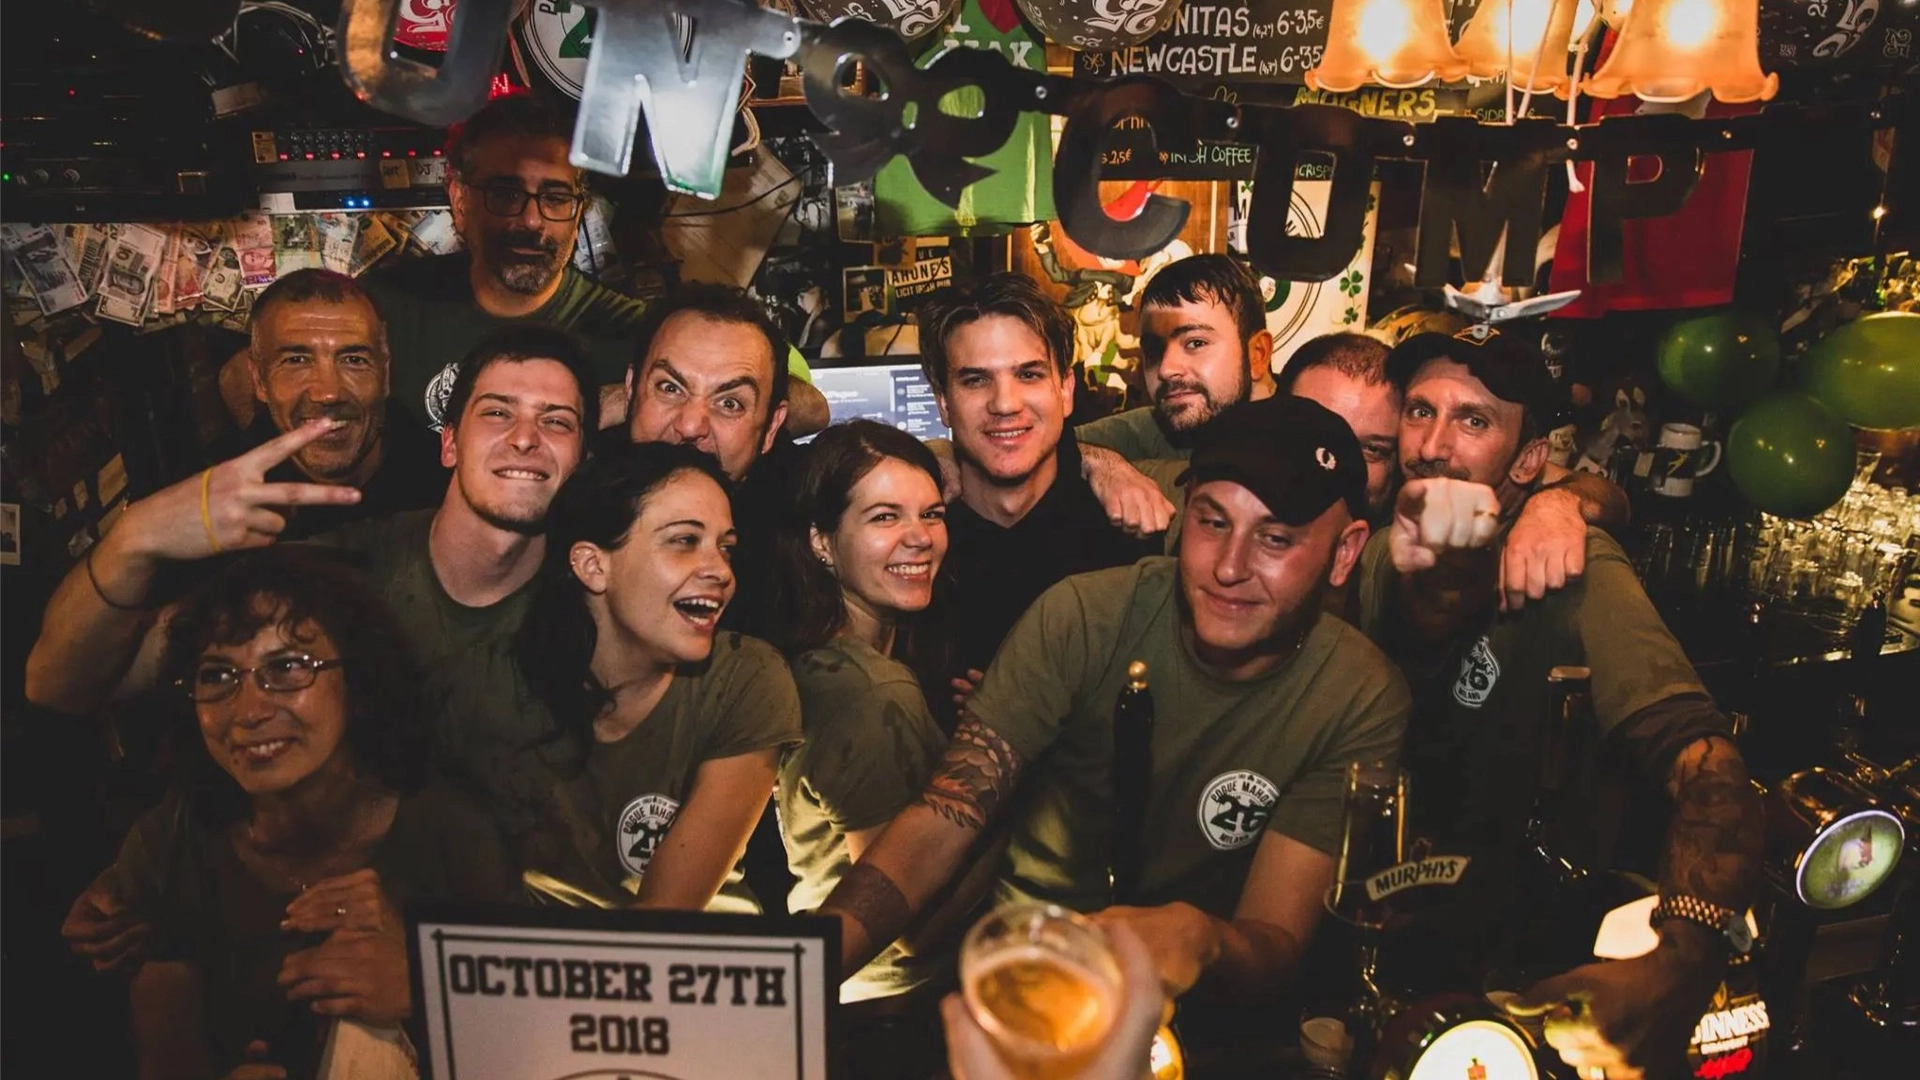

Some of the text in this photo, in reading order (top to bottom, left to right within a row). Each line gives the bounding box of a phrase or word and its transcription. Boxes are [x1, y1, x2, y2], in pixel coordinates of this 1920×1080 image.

[1161, 3, 1250, 37] NITAS
[1110, 43, 1257, 77] NEWCASTLE
[1280, 45, 1324, 74] 6-3,5
[1211, 147, 1252, 166] COFFEE
[449, 953, 787, 1006] OCTOBER 27TH
[569, 1013, 670, 1055] 2018
